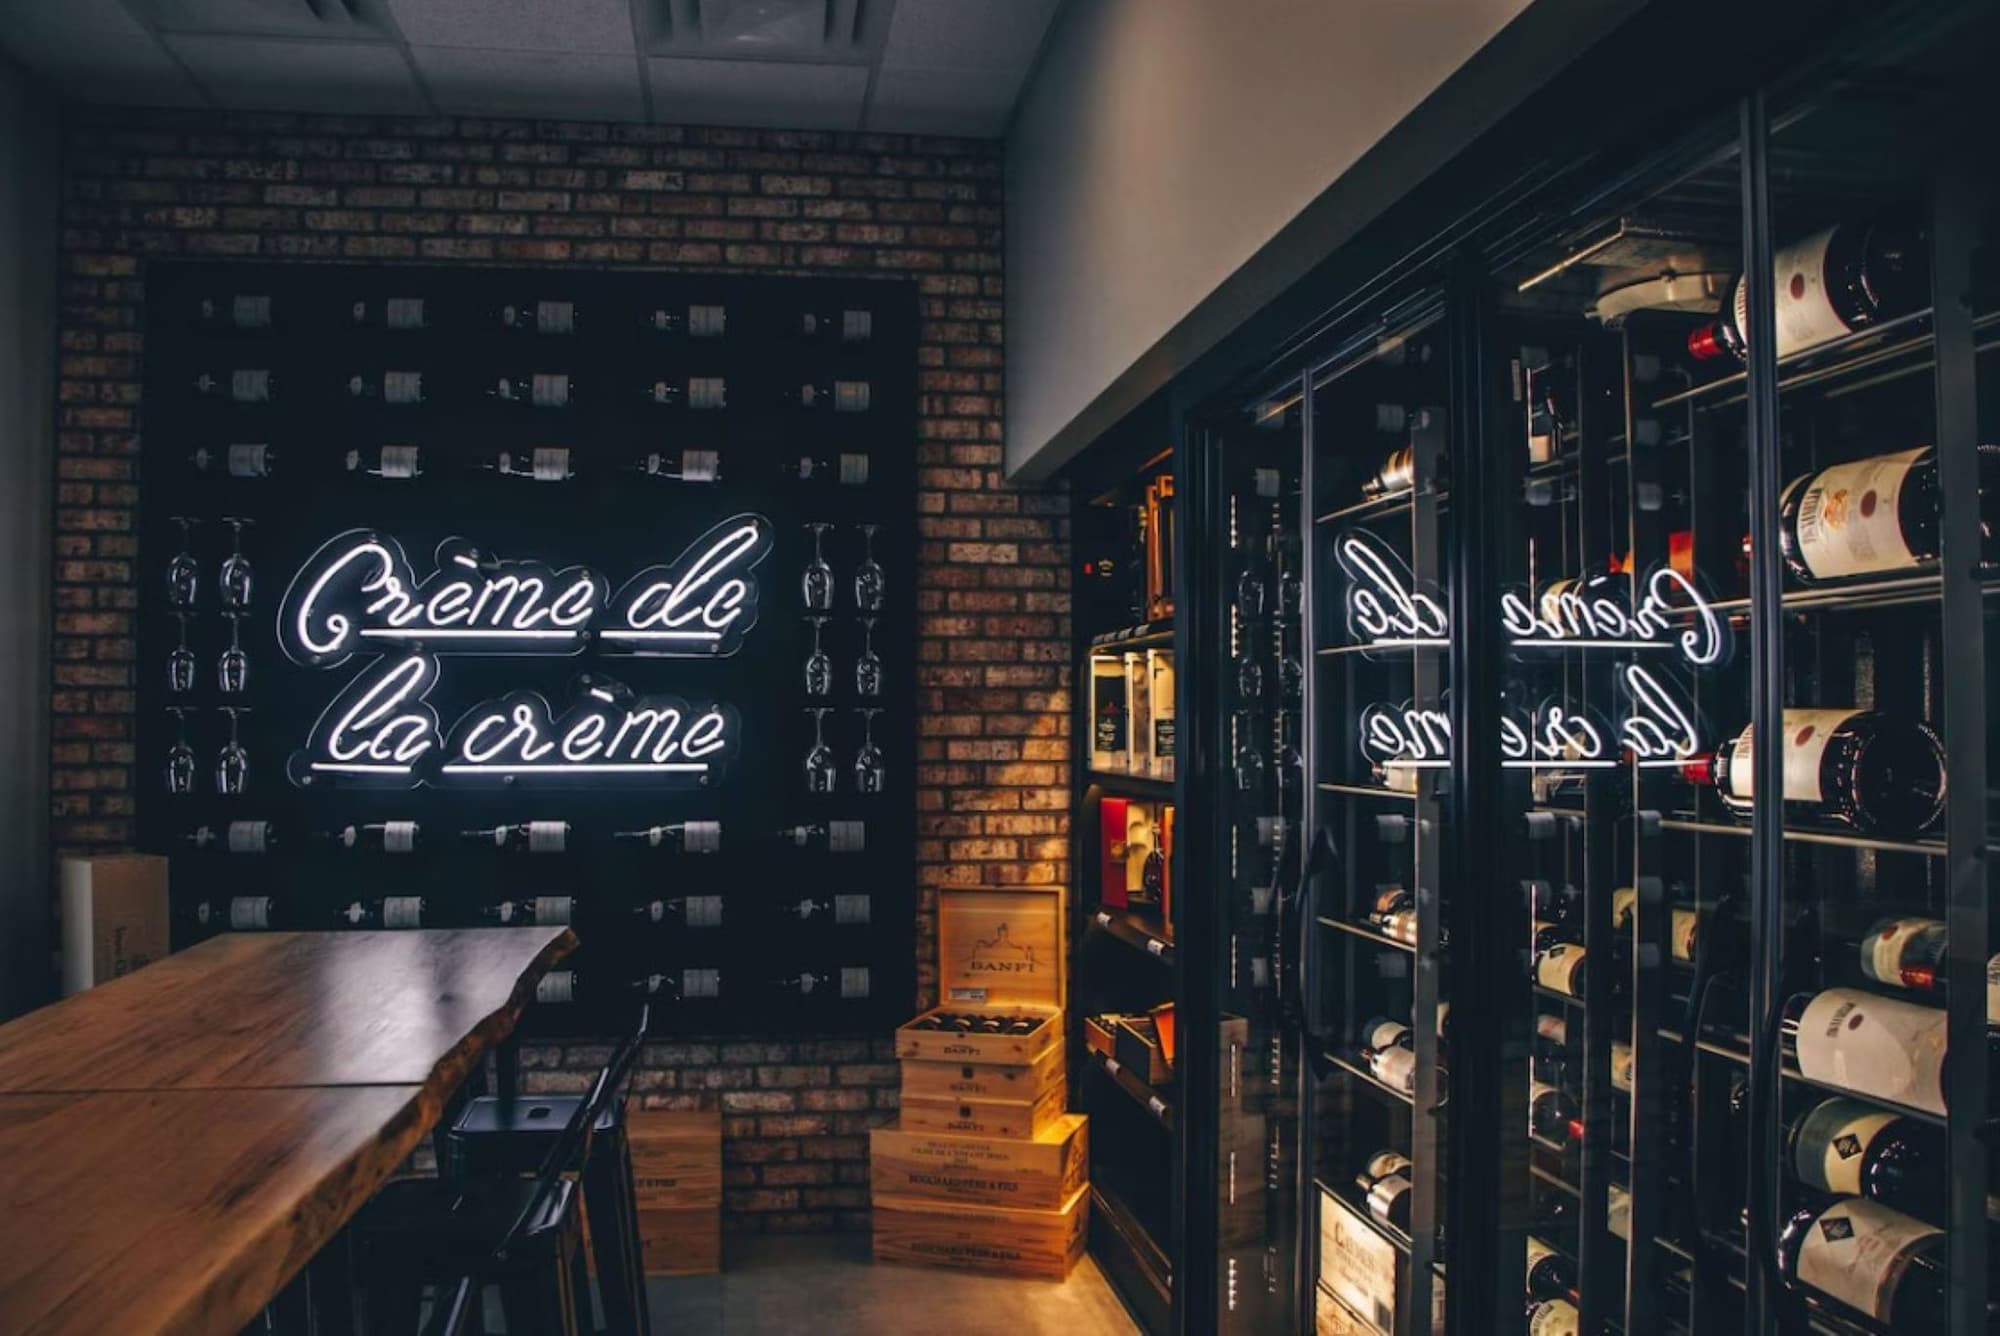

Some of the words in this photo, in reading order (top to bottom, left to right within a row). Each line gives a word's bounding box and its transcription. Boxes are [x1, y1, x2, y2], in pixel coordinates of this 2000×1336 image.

[297, 542, 595, 653] Crème
[626, 524, 758, 630] de
[327, 654, 432, 761] la
[461, 687, 726, 763] crème
[971, 961, 1035, 973] BANFI
